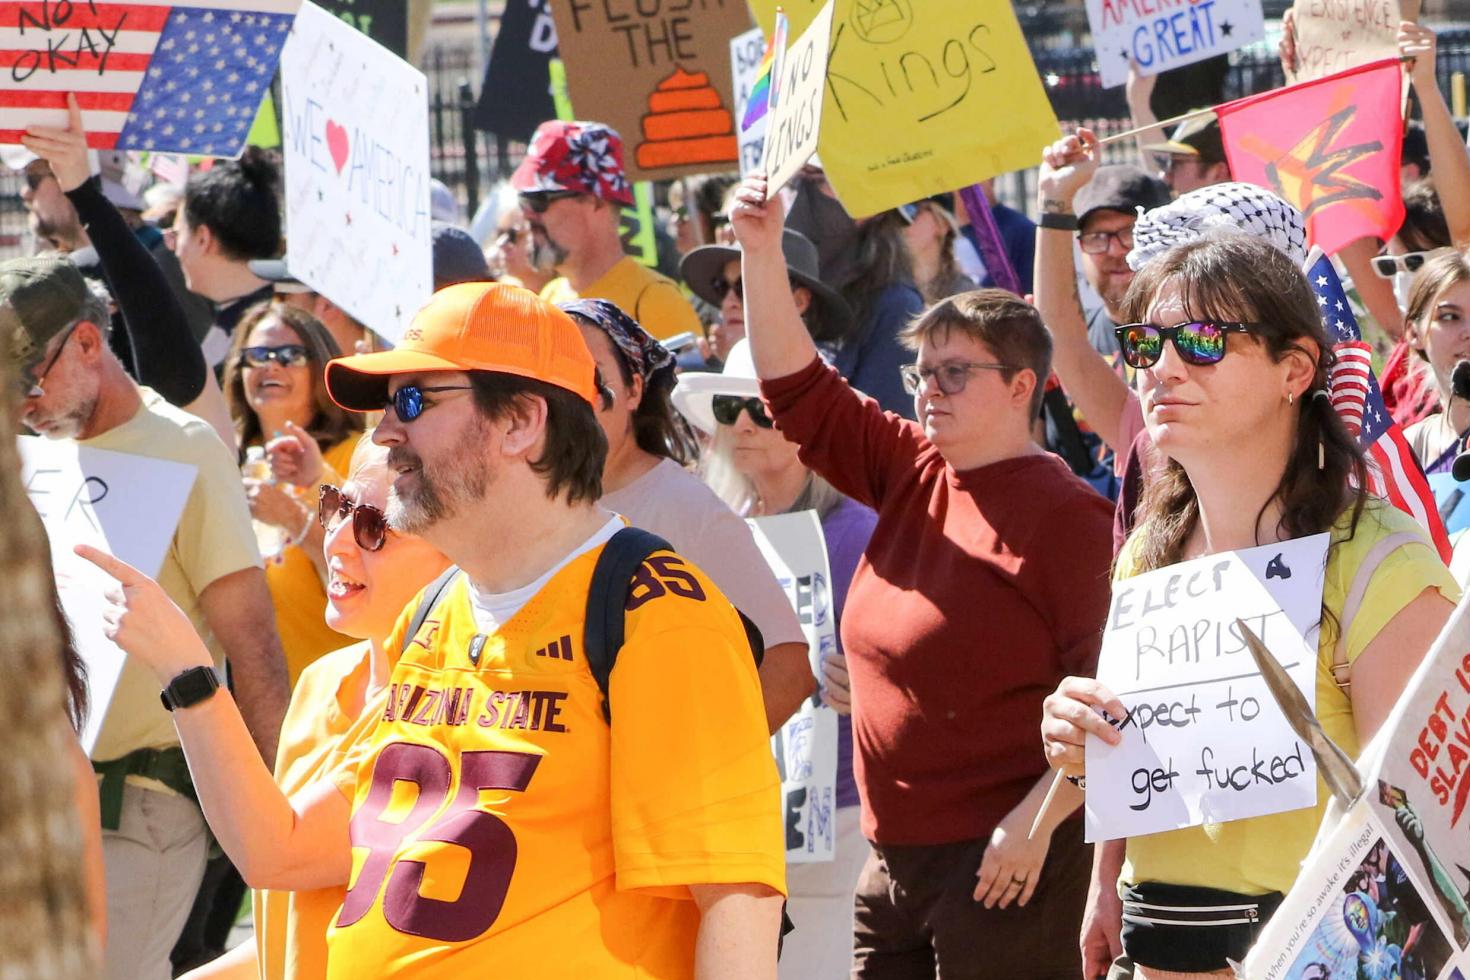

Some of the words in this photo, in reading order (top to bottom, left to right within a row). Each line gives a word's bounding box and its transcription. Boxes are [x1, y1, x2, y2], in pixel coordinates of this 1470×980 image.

[12, 12, 128, 83] OKAY
[612, 17, 697, 68] THE
[1132, 1, 1216, 67] GREAT
[786, 40, 814, 106] NO
[826, 23, 997, 123] Kings
[285, 83, 327, 173] WE
[1112, 560, 1232, 631] ELECT
[1265, 552, 1292, 579] A
[1135, 608, 1286, 681] RAPIST
[381, 683, 474, 726] ARIZNA
[478, 688, 569, 734] STATE
[1215, 686, 1261, 724] to
[1409, 690, 1456, 780] DEBT
[1129, 757, 1180, 811] get
[1195, 742, 1306, 791] fucked
[1287, 921, 1309, 955] you're
[1306, 905, 1318, 919] so
[1316, 871, 1340, 908] awake
[1350, 822, 1375, 859] illegal
